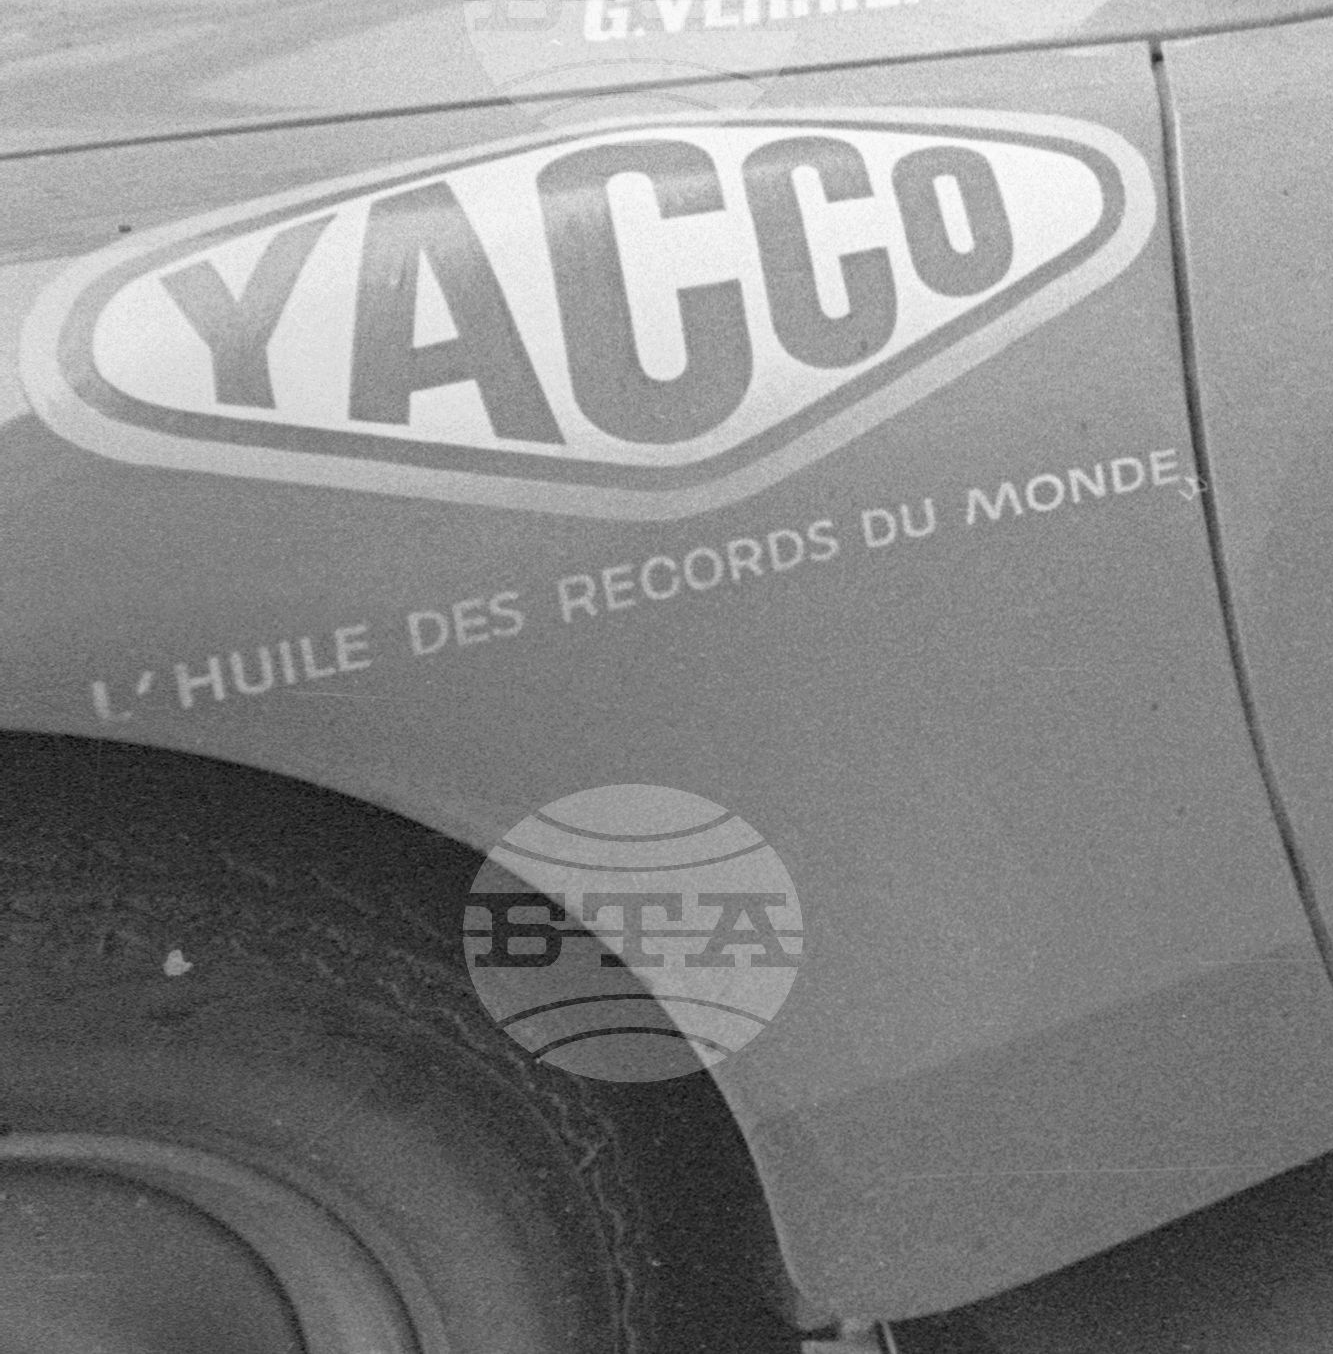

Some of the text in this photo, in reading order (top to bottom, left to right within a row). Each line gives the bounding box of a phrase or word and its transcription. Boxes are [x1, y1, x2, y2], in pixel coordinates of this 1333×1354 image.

[158, 134, 1015, 446] YACCO
[407, 590, 525, 657] DES
[557, 519, 840, 623] RECORDS
[861, 497, 936, 549] DU
[965, 449, 1180, 526] MONDE
